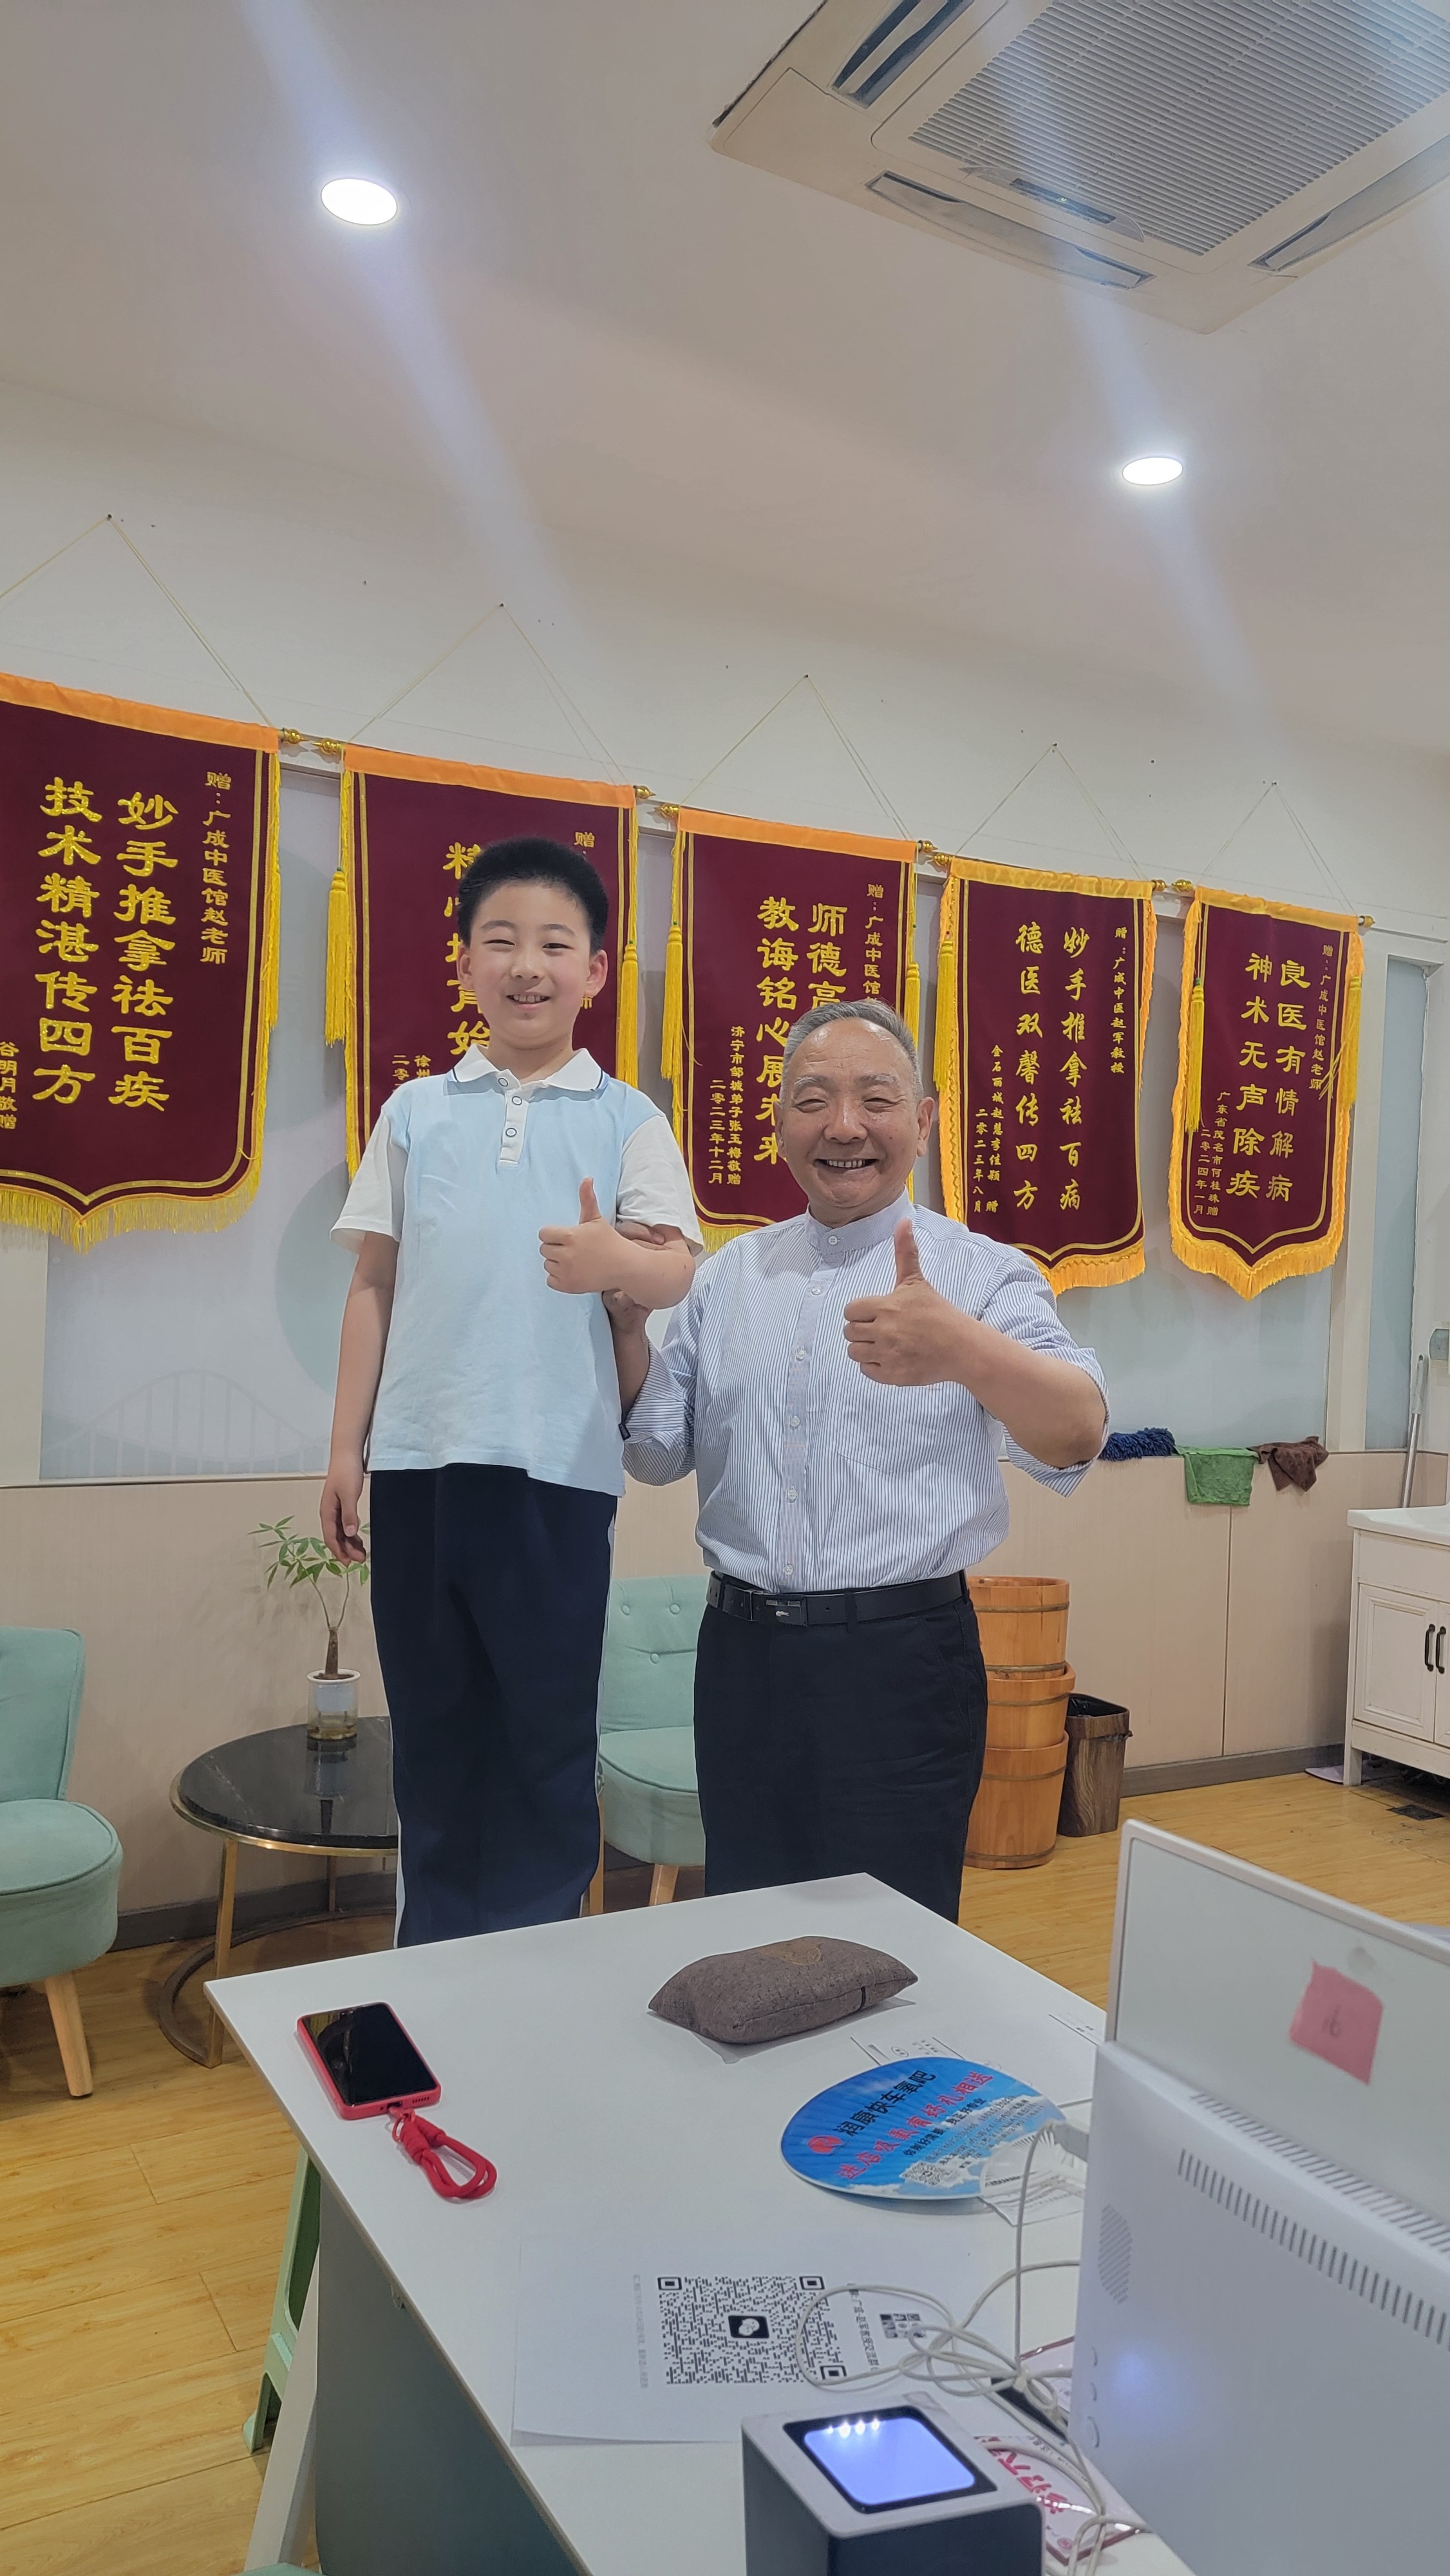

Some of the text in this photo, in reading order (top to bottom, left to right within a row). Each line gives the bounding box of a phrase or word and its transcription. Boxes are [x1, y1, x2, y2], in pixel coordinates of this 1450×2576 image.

[32, 776, 103, 1105] 技术精湛传四方
[108, 791, 180, 1112] 妙手推拿祛百疾
[200, 772, 232, 965] 赠：广成中医馆赵老师
[708, 1079, 727, 1185] 二零二三年十二月
[973, 1108, 989, 1213] 二零二三年八月
[1013, 921, 1045, 1211] 德医双馨传四方
[1059, 926, 1091, 1211] 妙手推拿祛百病
[1193, 1128, 1212, 1215] 二零二四年一月
[1226, 952, 1274, 1200] 神术无声除疾
[1265, 960, 1312, 1202] 良医有情解病
[835, 2070, 994, 2180] 进店吸氧有好礼相送
[836, 2070, 937, 2137] 润康快车氧吧
